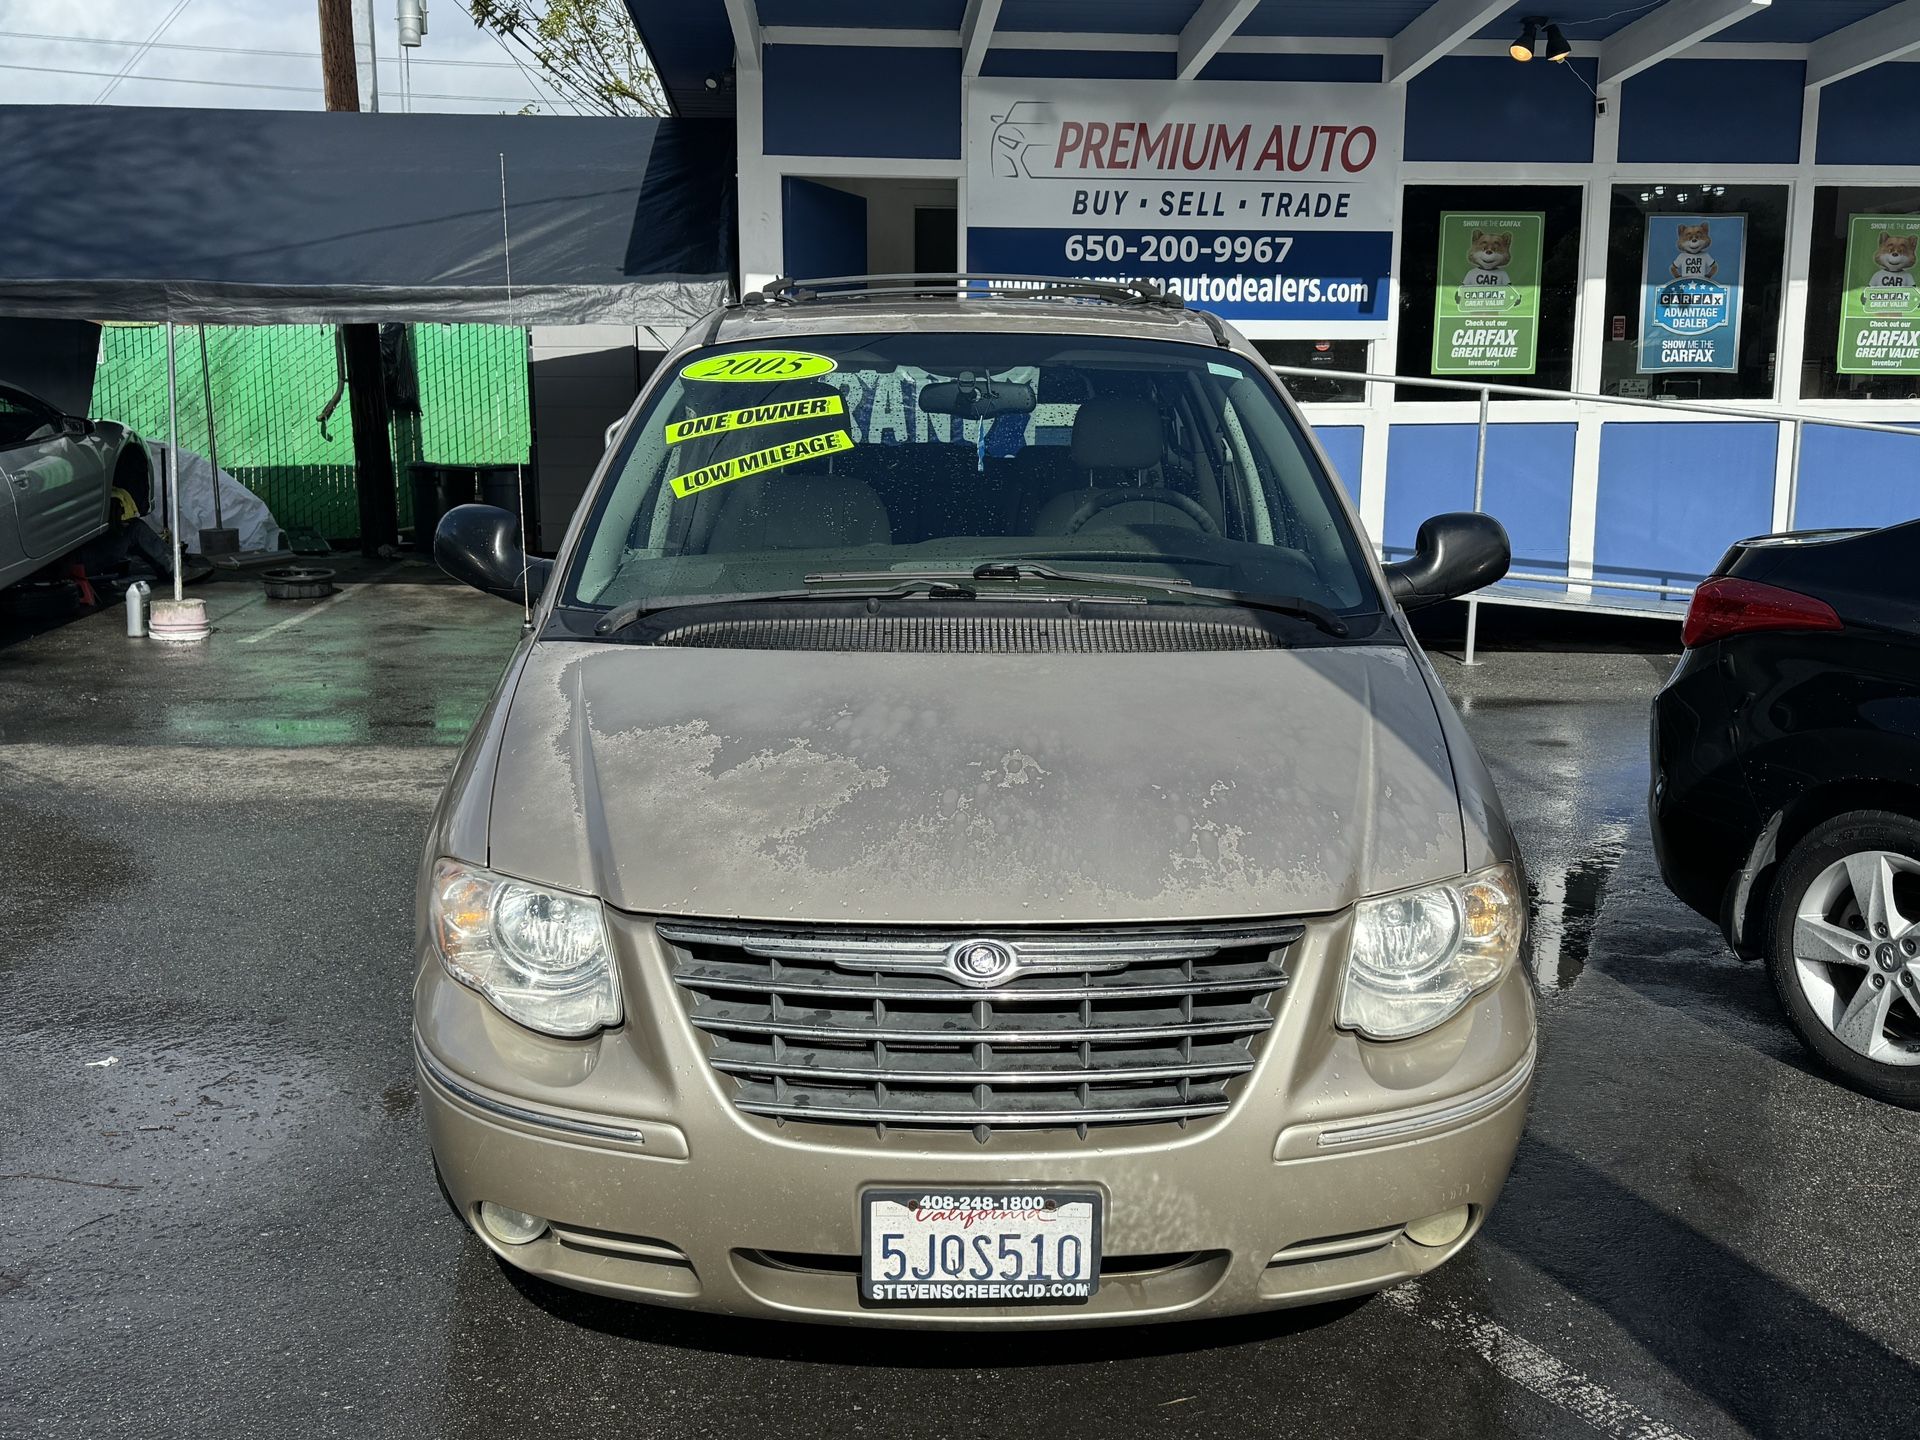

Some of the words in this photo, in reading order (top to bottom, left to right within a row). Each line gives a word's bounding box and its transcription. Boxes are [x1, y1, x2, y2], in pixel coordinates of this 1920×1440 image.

[1054, 121, 1251, 171] PREMIUM
[1253, 124, 1377, 173] AUTO
[1072, 190, 1129, 215] BUY
[1159, 191, 1225, 217] SELL
[1260, 192, 1350, 218] TRADE
[1065, 234, 1294, 263] 650-200-9967
[1685, 257, 1702, 265] CAR
[1685, 266, 1701, 274] FOX
[1476, 274, 1498, 285] CAR
[1881, 276, 1903, 286] CAR
[1464, 291, 1506, 299] CARFAX
[1661, 293, 1723, 305] CARFAX
[1664, 307, 1718, 317] ADVANTAGE
[1672, 318, 1708, 328] DEALER
[1451, 329, 1519, 346] CARFAX
[1856, 329, 1920, 346] CARFAX
[1662, 340, 1686, 349] SHOW
[1687, 340, 1699, 349] ME
[1701, 340, 1714, 349] THE
[1451, 347, 1485, 358] GREAT
[1485, 347, 1518, 358] VALUE
[1661, 349, 1714, 363] CARFAX
[1855, 347, 1888, 358] GREAT
[1888, 348, 1920, 358] VALUE
[702, 356, 814, 377] 2005
[1468, 359, 1500, 367] Inventory!
[1871, 359, 1902, 367] Inventory!
[677, 413, 731, 438] ONE
[736, 399, 831, 425] OWNER
[682, 462, 735, 492] LOW
[738, 433, 843, 473] MILEAGE
[919, 1195, 1045, 1211] 408-248-1800
[881, 1233, 1082, 1280] 5JQS510
[872, 1282, 1089, 1300] STEVENSCREEKCJD.COM
